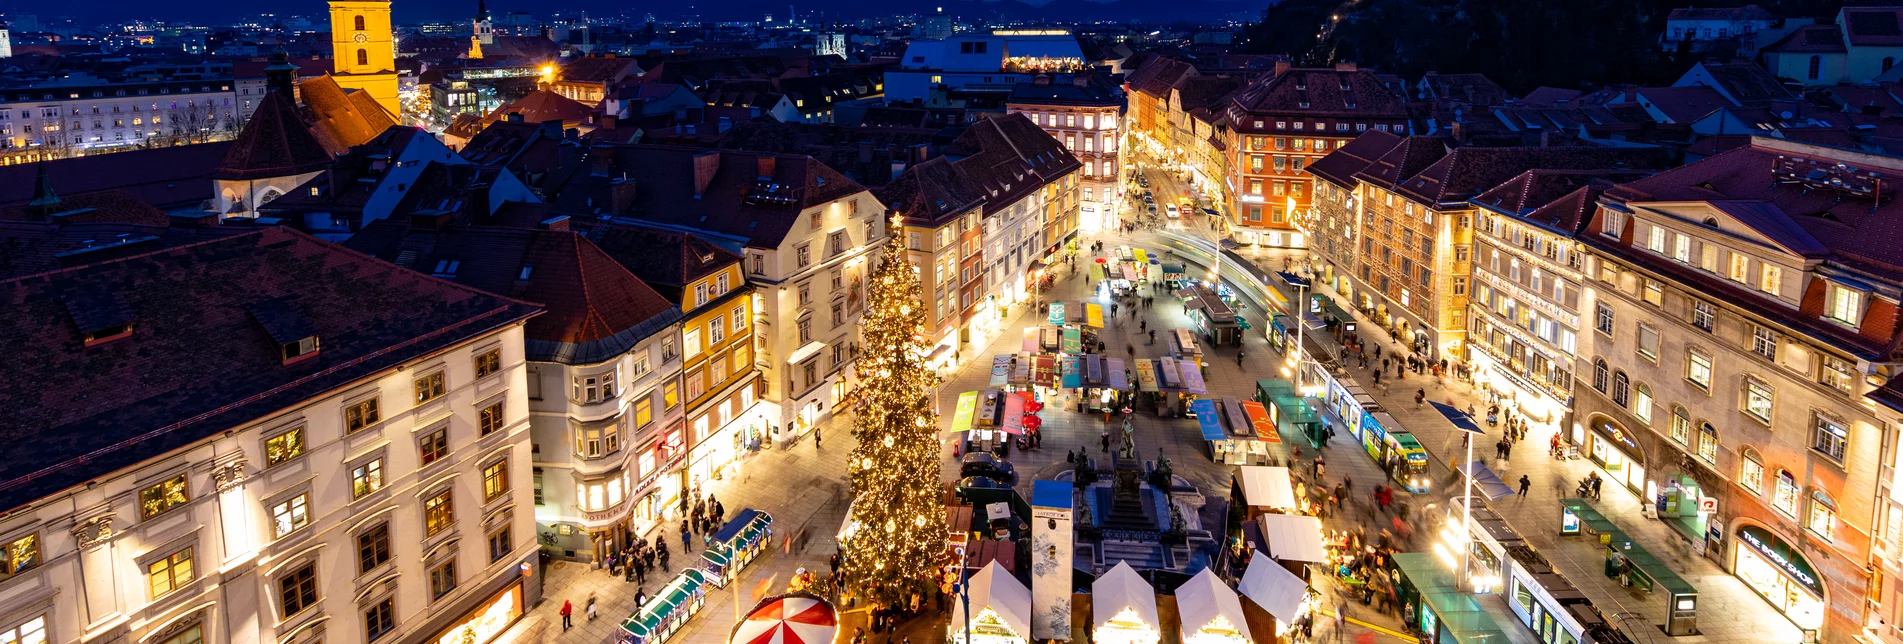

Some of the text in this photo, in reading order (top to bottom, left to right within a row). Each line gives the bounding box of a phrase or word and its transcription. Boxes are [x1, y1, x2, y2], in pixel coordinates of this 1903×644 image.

[634, 477, 655, 496] ADLER
[581, 505, 625, 521] APOTHEKE
[1743, 530, 1814, 585] THE BODY SHOP
